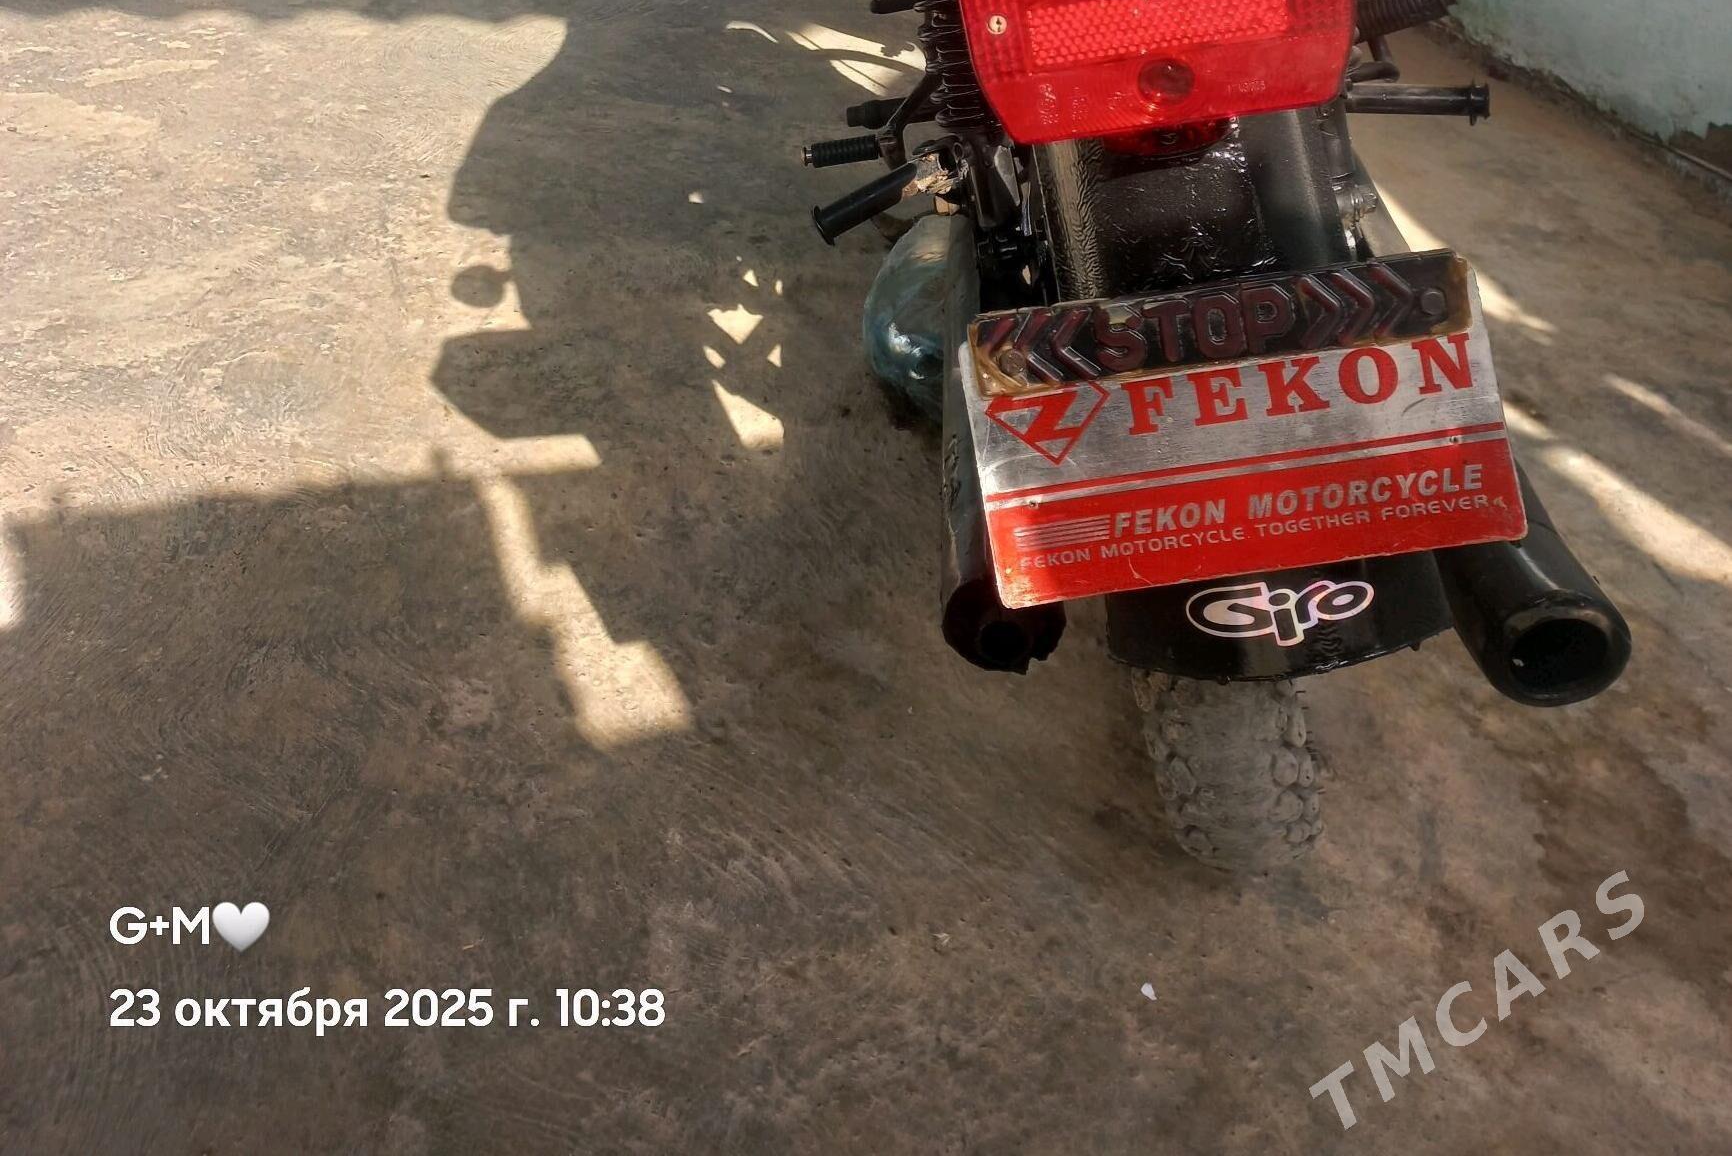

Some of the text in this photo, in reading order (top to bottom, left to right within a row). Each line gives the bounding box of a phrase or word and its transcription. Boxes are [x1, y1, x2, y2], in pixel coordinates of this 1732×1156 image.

[1094, 281, 1296, 373] STOP
[1121, 332, 1473, 436] FEKON
[1020, 547, 1091, 570] FEKON
[1255, 511, 1370, 538] TOGETHER
[1381, 495, 1489, 521] FOREVER
[1114, 464, 1482, 538] FEKON MOTORCYCLE
[1186, 580, 1375, 647] Giro
